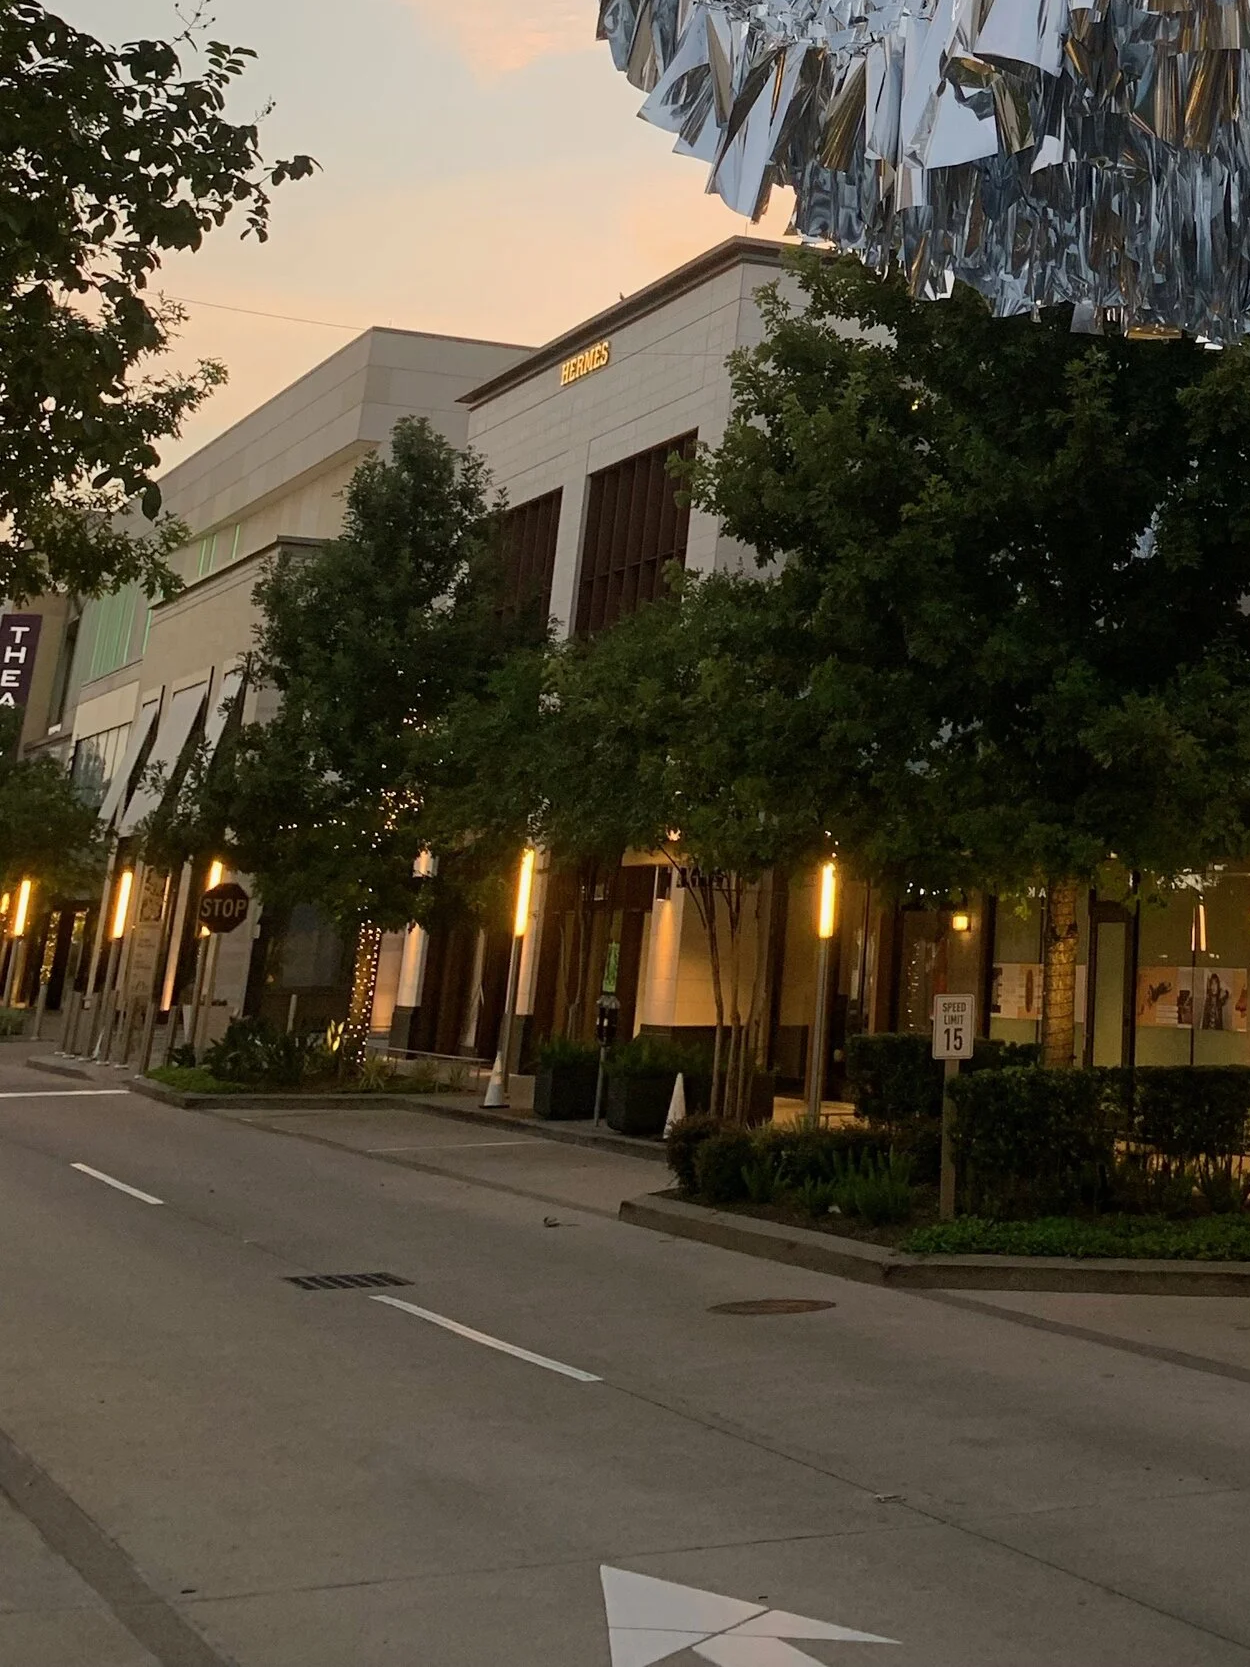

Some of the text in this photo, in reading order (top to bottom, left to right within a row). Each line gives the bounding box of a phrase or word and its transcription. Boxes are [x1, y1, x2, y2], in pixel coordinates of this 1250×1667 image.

[200, 898, 247, 918] STOP
[942, 1002, 967, 1013] SPEED
[943, 1014, 964, 1025] LIMIT
[943, 1027, 963, 1051] 15
